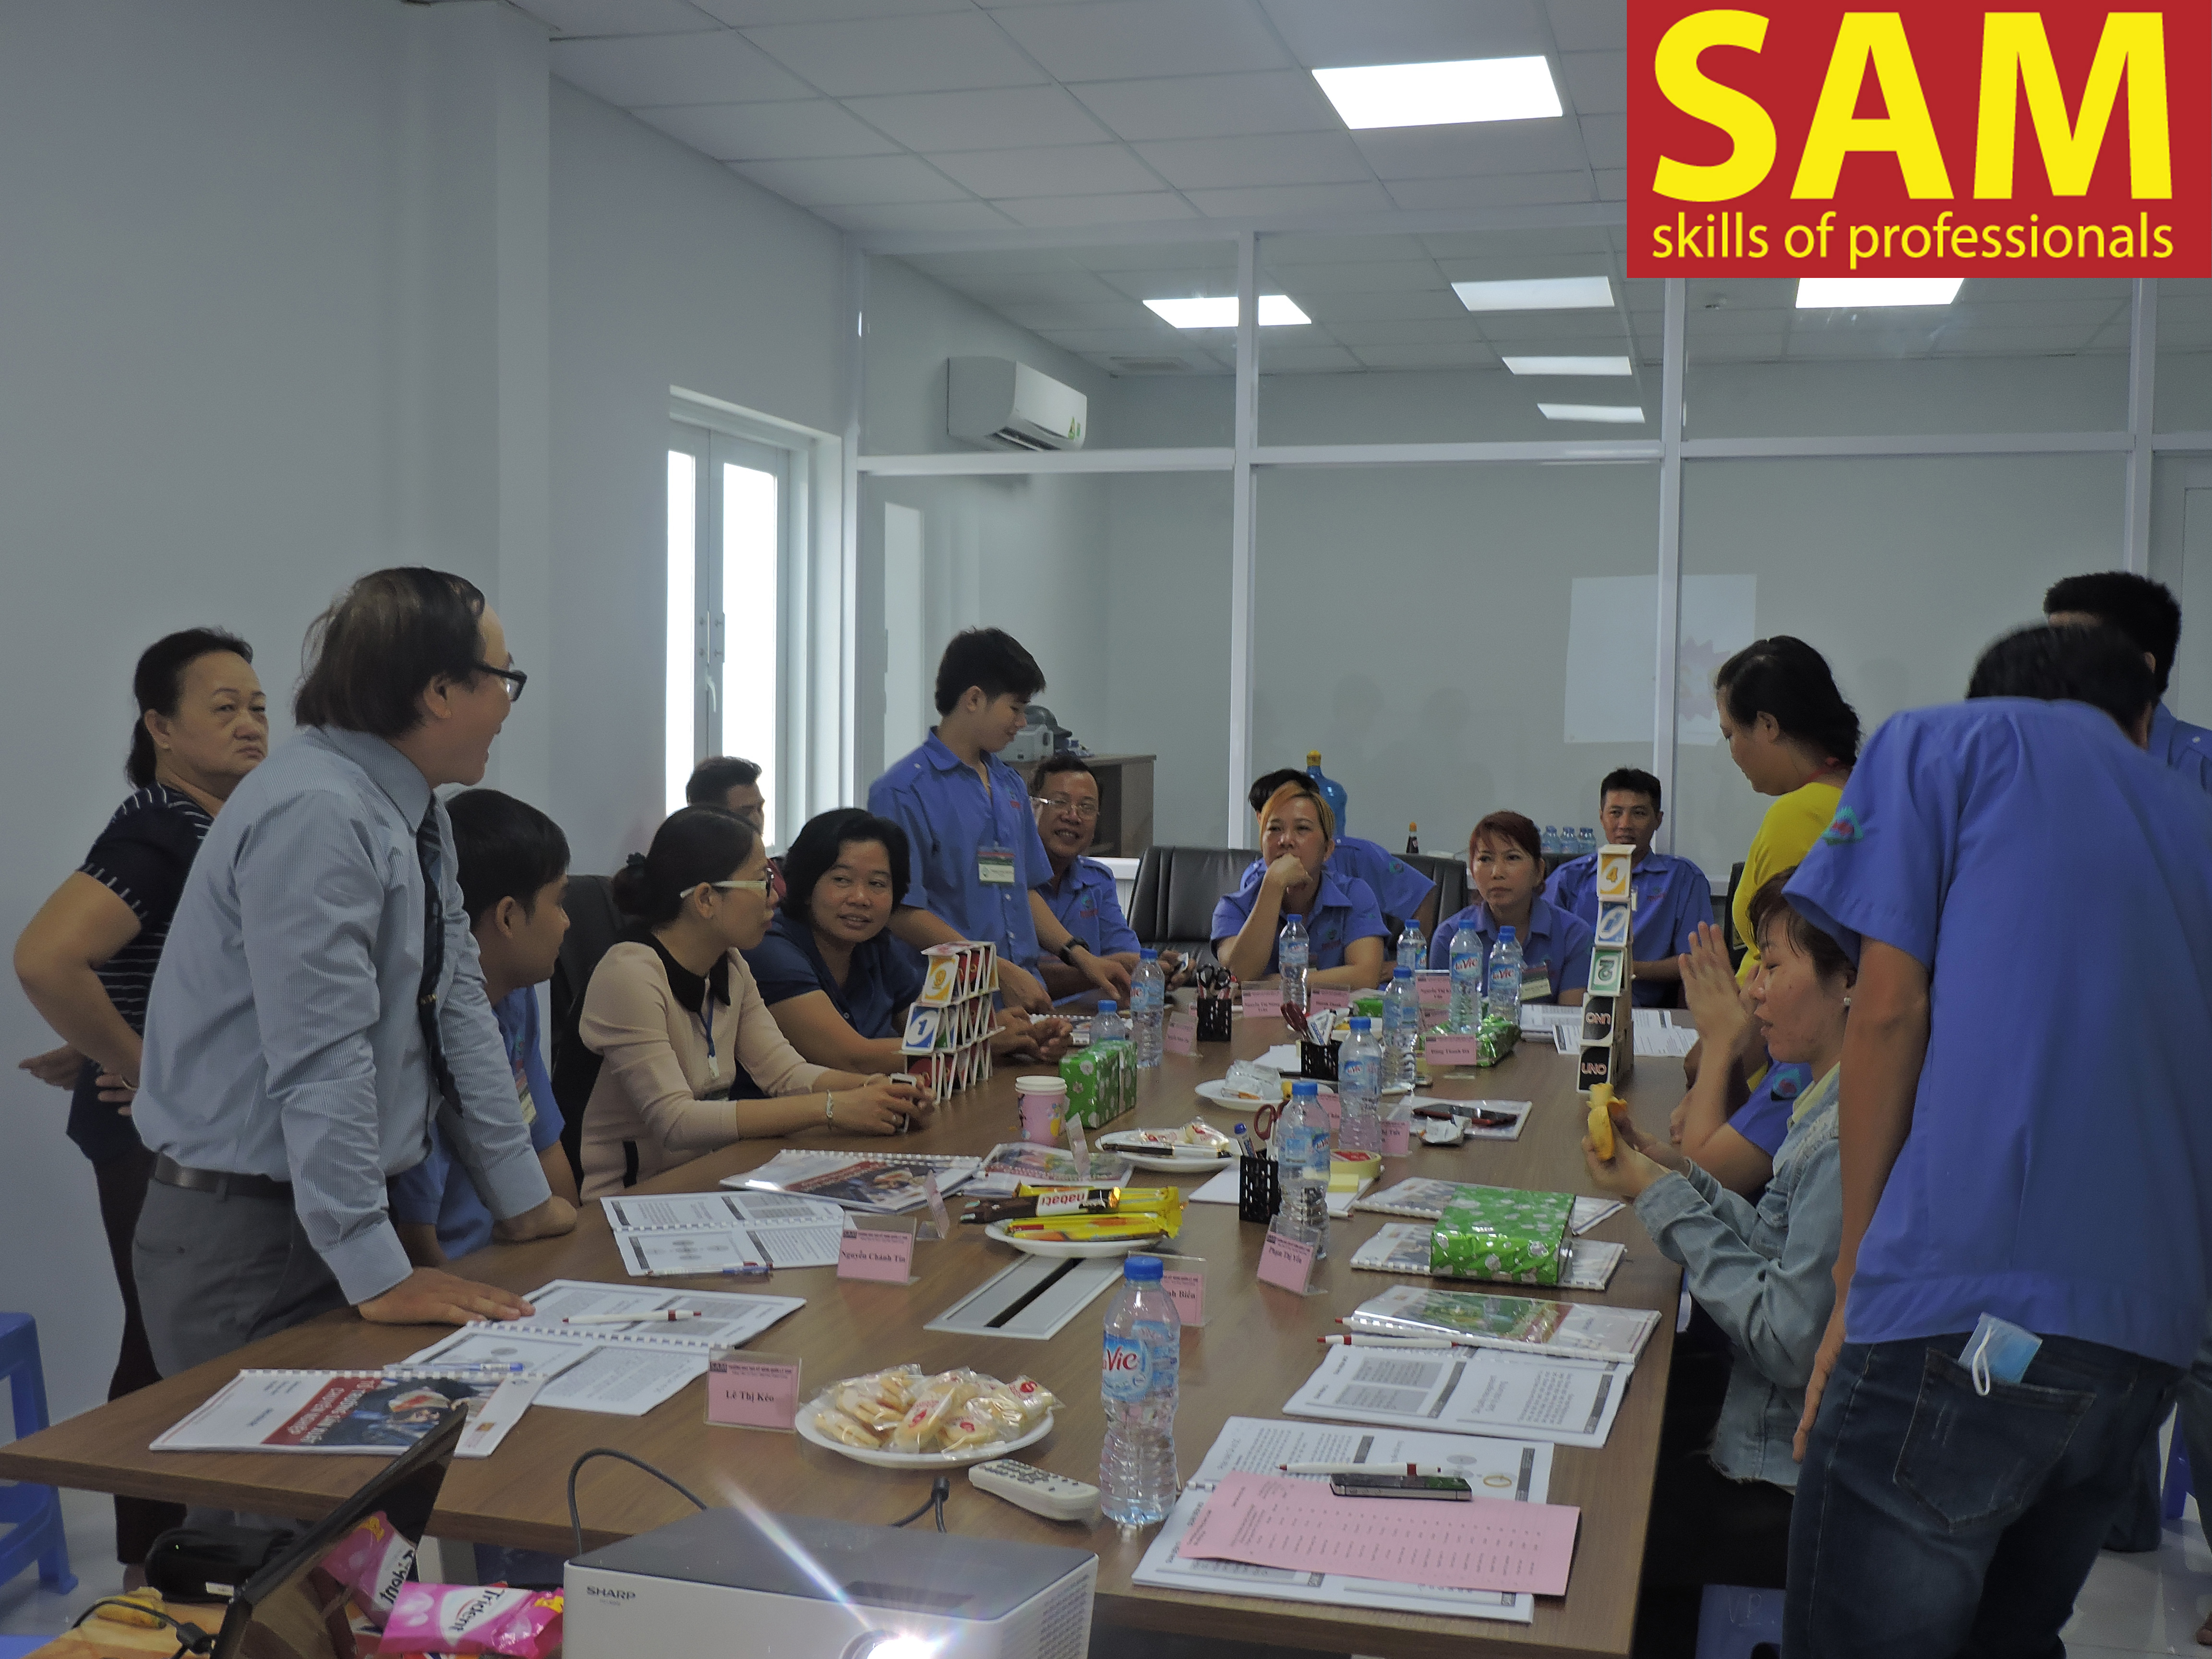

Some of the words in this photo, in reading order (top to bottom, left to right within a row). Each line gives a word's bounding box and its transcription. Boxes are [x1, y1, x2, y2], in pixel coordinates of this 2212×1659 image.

[1606, 866, 1618, 882] 4
[1586, 1012, 1611, 1024] UNO
[918, 1019, 927, 1035] 1
[1581, 1062, 1607, 1075] UNO
[1042, 1193, 1084, 1206] nabati
[739, 1391, 755, 1403] Thị
[587, 1586, 636, 1599] SHARP
[448, 1588, 505, 1632] Trident
